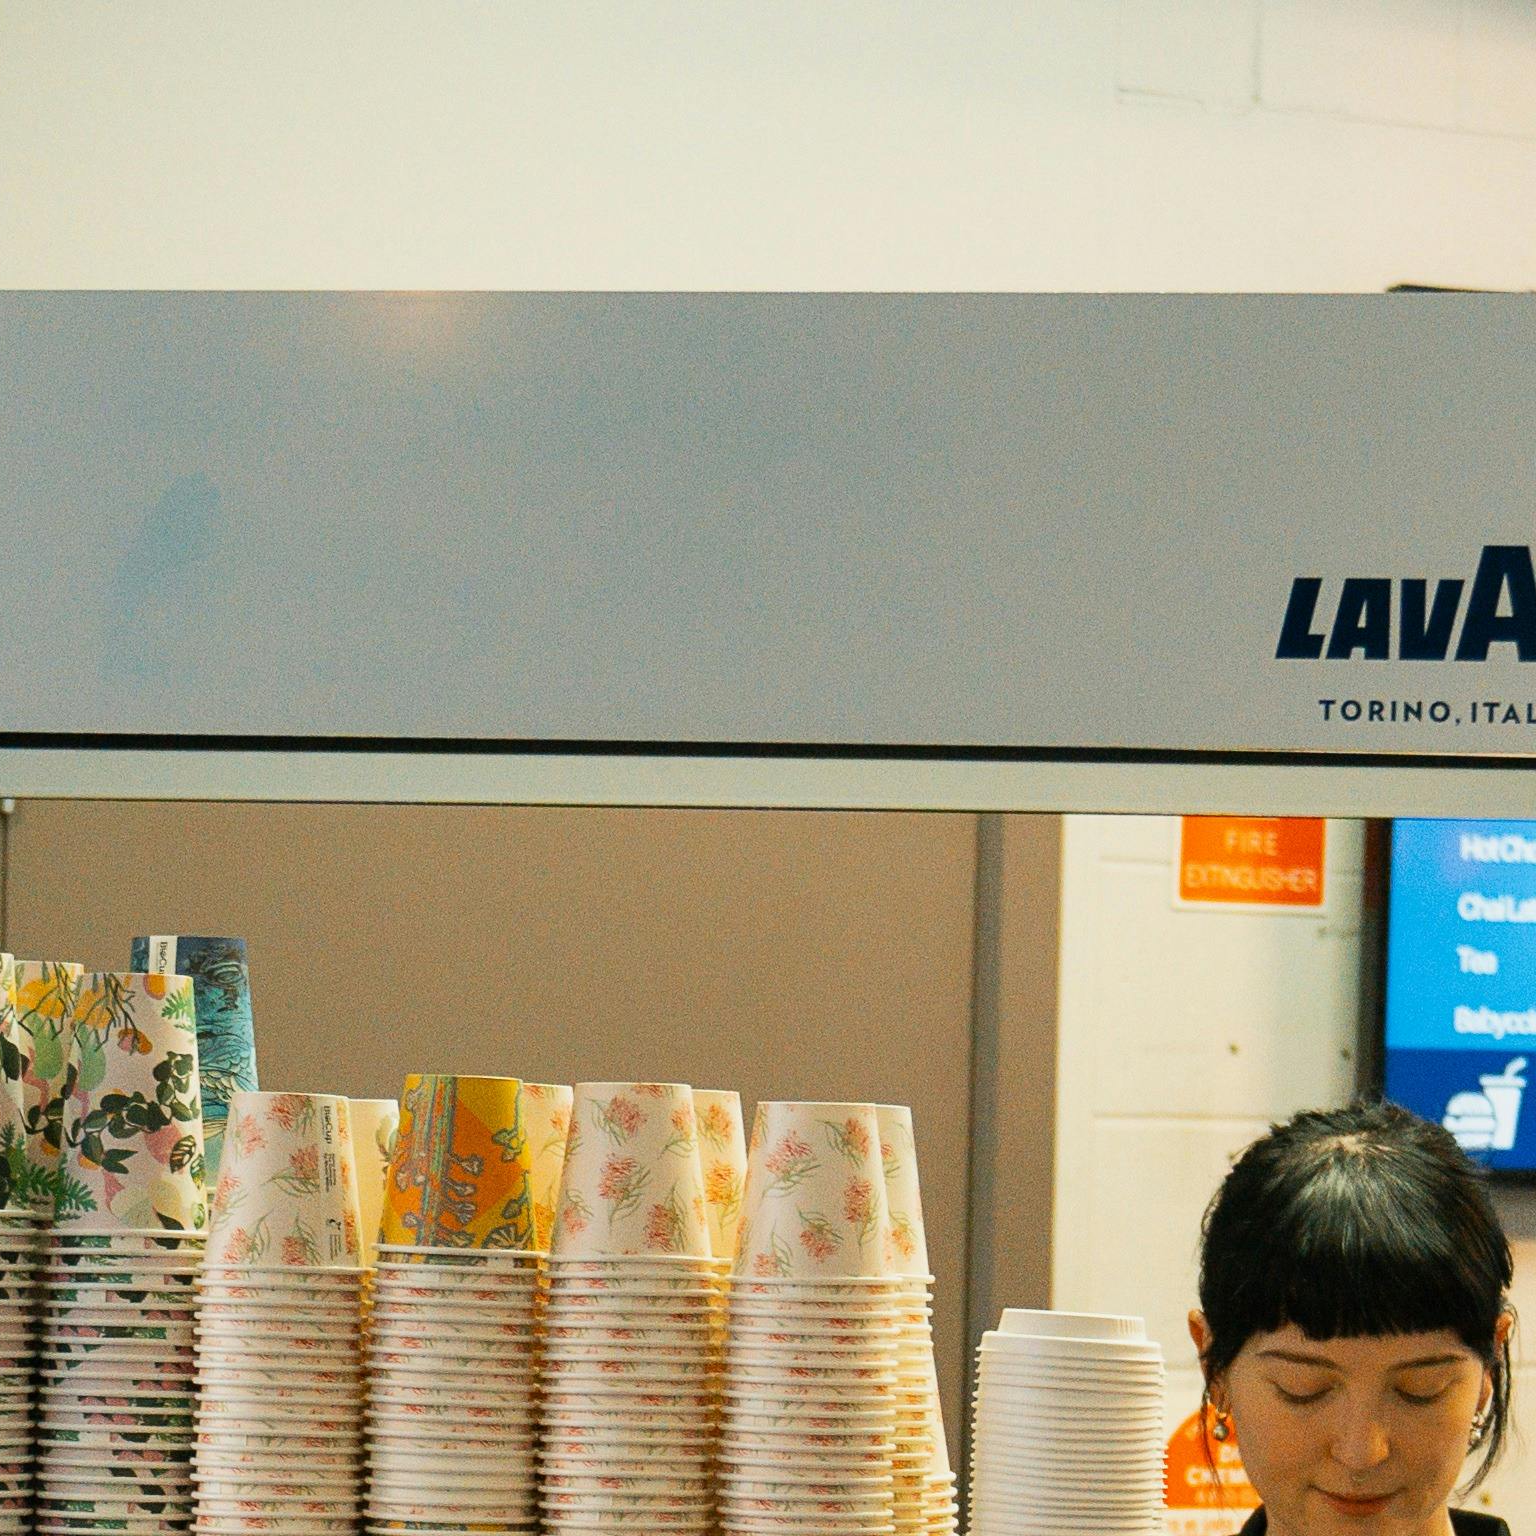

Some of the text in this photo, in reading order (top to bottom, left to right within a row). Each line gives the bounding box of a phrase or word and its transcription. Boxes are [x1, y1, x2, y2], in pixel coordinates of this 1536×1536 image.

[1224, 829, 1278, 856] FIRE
[1460, 832, 1499, 862] Hot
[1185, 862, 1317, 894] EXTINGUISHER
[159, 941, 168, 974] BioCu
[1457, 943, 1499, 976] Tea
